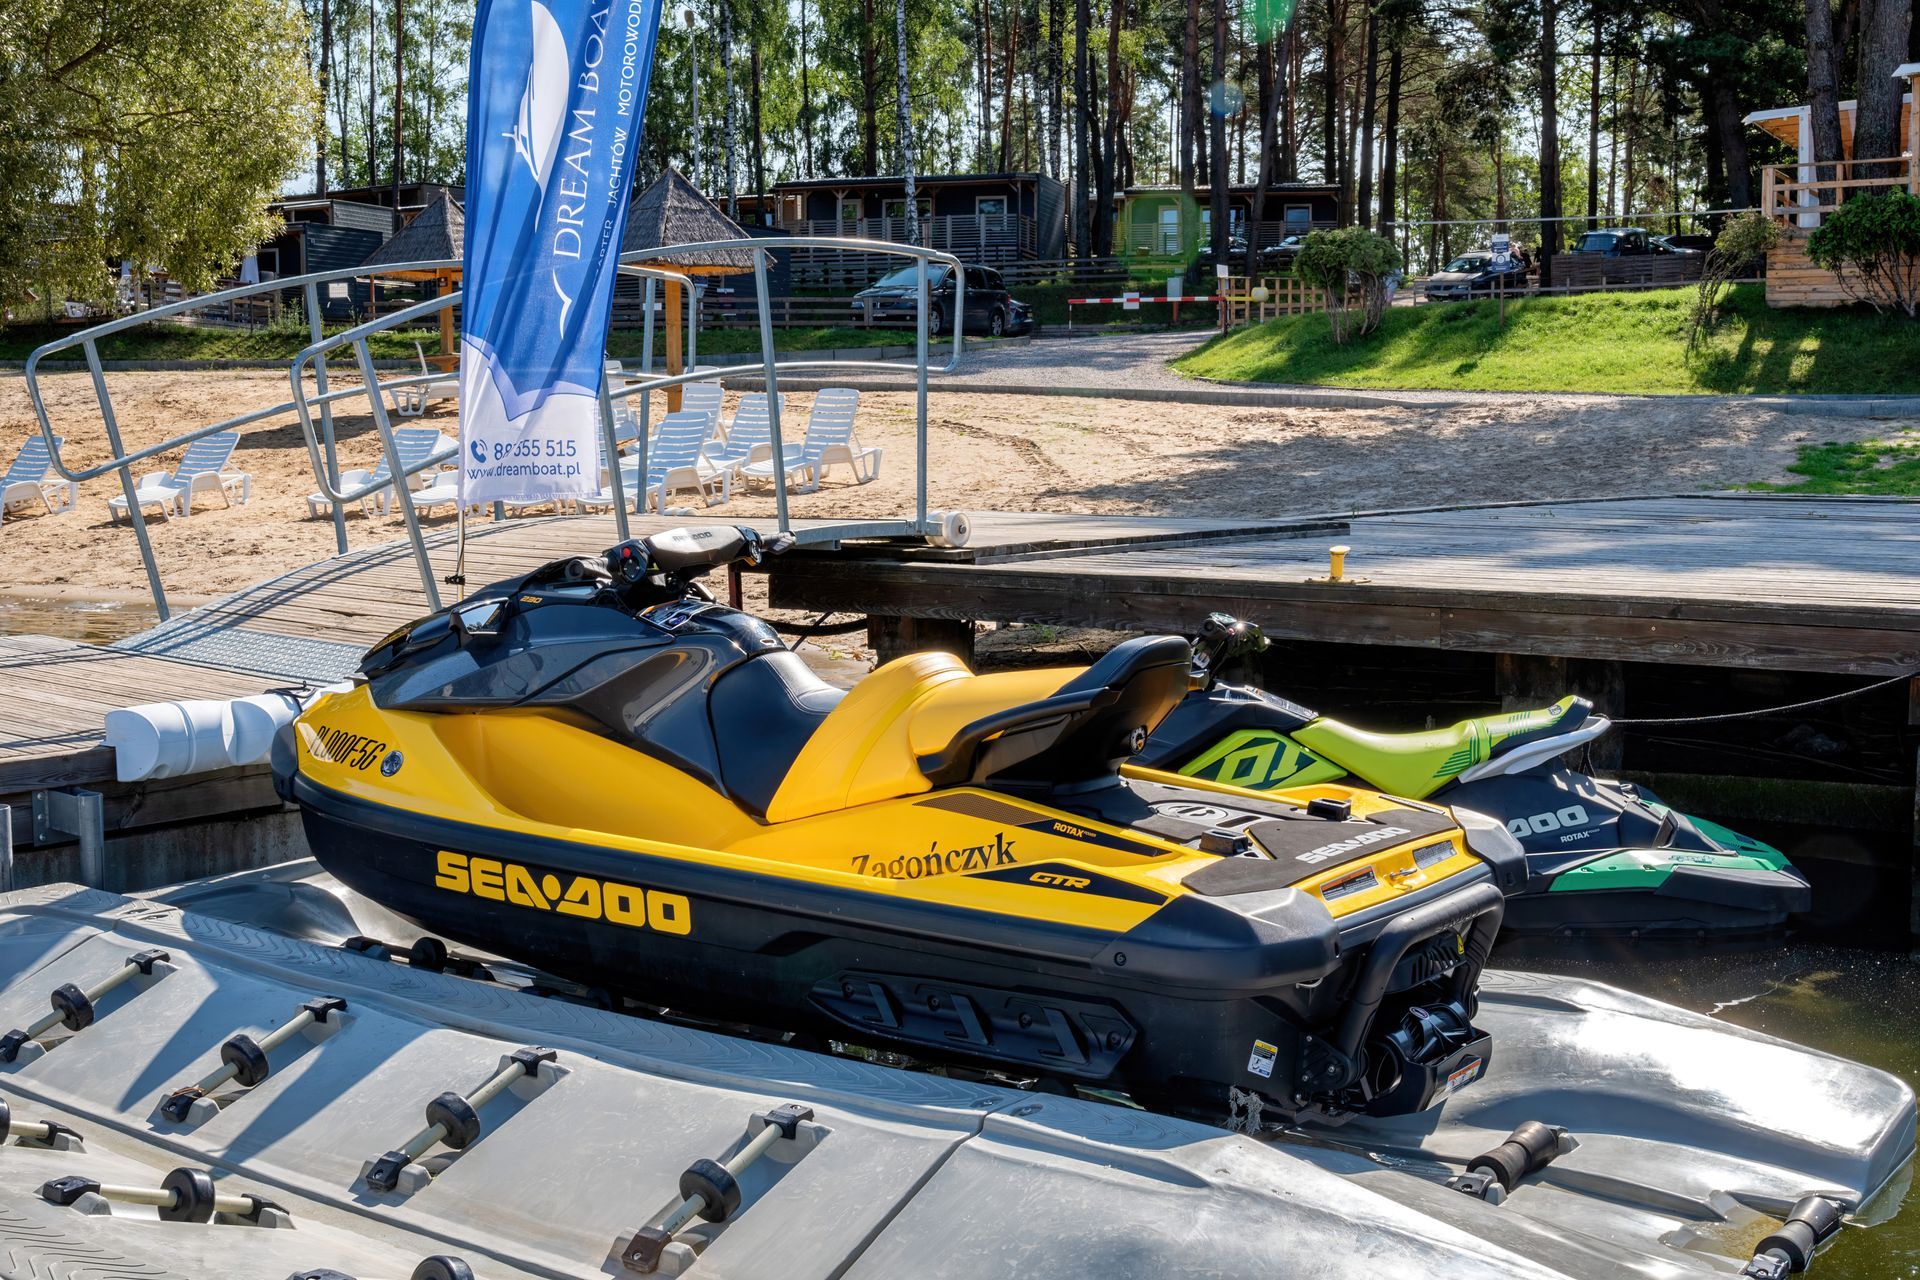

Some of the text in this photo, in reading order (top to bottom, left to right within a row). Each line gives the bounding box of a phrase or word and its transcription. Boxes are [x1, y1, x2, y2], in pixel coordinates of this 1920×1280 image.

[617, 0, 643, 116] MOTOROWOD
[553, 0, 610, 260] DREAM BOA
[607, 127, 628, 208] JACHTÓW
[545, 439, 577, 458] 515
[1053, 822, 1084, 838] ROTAX
[1560, 831, 1590, 843] ROTAX
[851, 832, 1018, 880] Zagończyk
[1029, 871, 1091, 889] GTR
